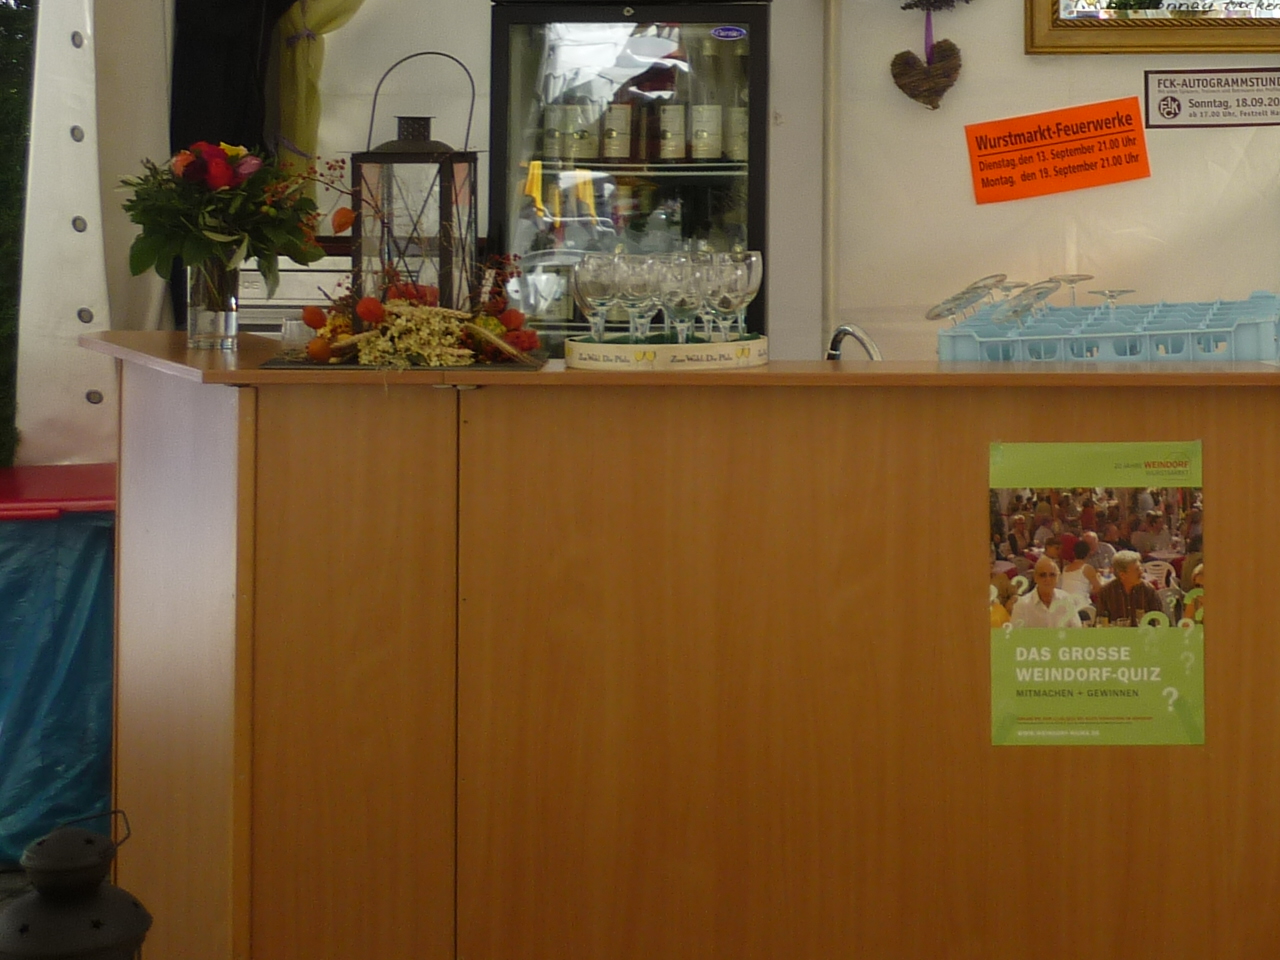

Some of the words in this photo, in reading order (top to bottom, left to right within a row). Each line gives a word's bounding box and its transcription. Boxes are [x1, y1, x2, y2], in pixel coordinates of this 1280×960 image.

[1188, 98, 1232, 110] Sonntag,
[975, 111, 1133, 151] Wurstmarkt-Feuerwerke
[1018, 153, 1034, 166] den
[1051, 143, 1095, 161] September
[1098, 138, 1120, 152] 21.00
[1121, 135, 1137, 148] Uhr
[1020, 168, 1037, 182] den
[1053, 159, 1098, 178] September
[1101, 154, 1122, 169] 21.00
[1125, 152, 1140, 165] Uhr
[1144, 460, 1189, 469] WEINDORF
[1016, 647, 1051, 661] DAS
[1058, 647, 1131, 661] GROSSE
[1016, 667, 1162, 683] WEINDORF-QUIZ
[1016, 689, 1074, 697] MITMACHEN
[1087, 689, 1139, 697] GEWINNEN
